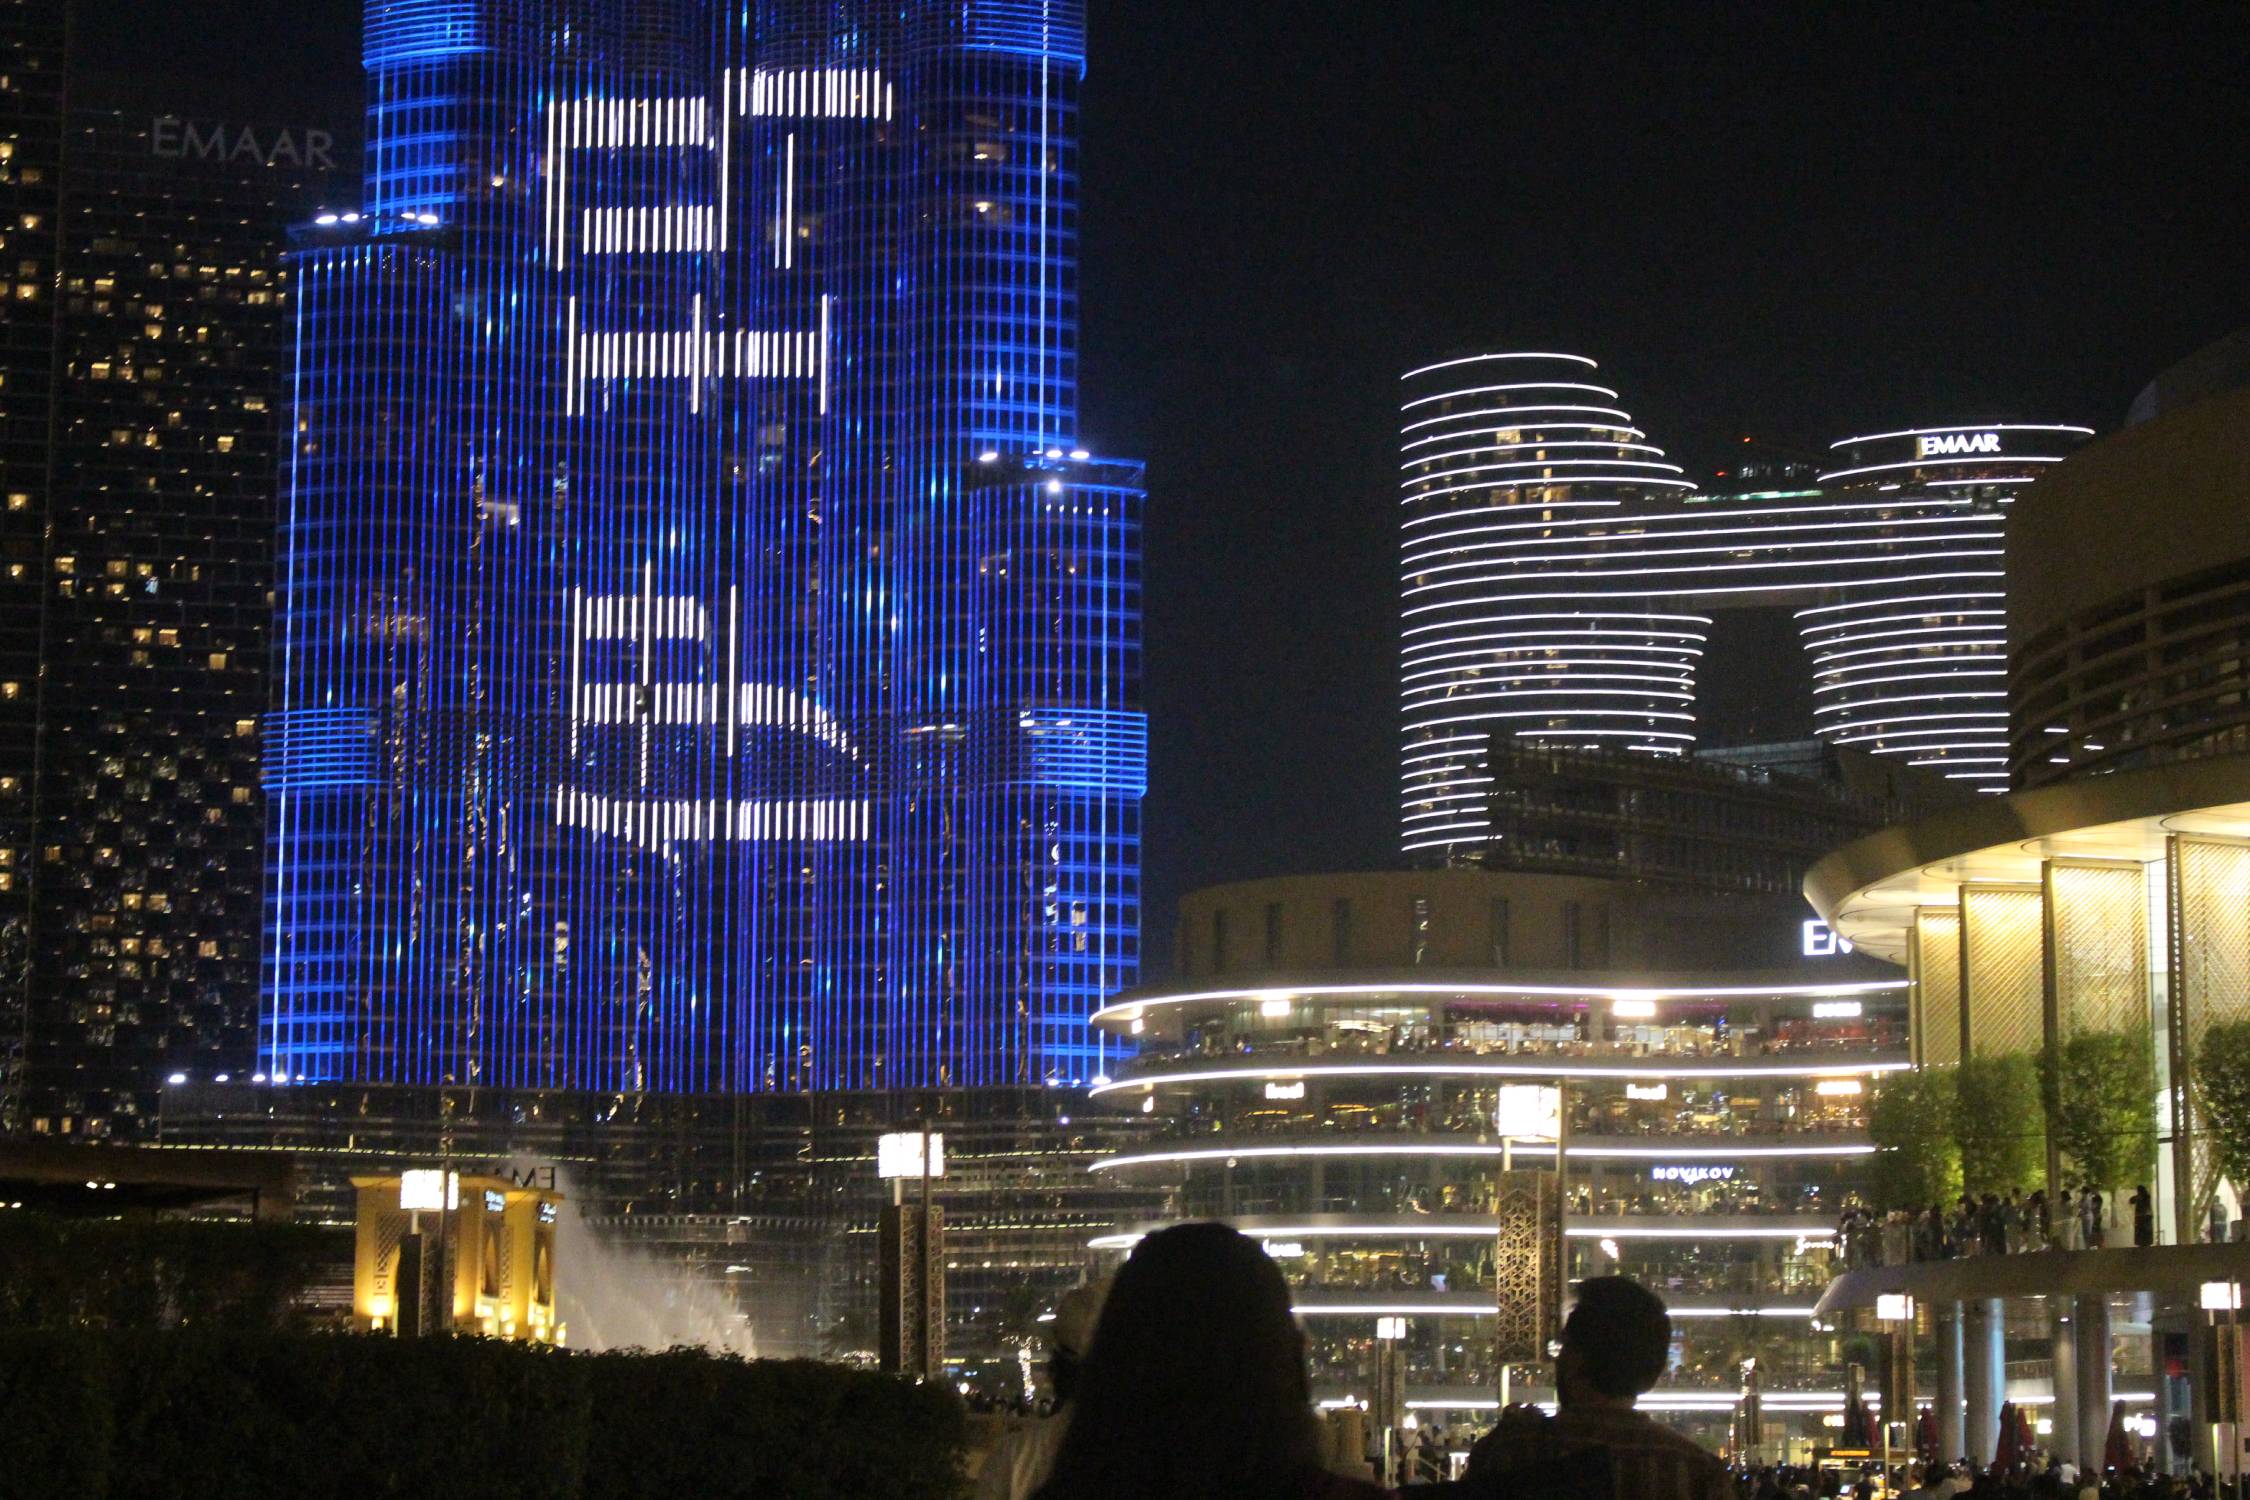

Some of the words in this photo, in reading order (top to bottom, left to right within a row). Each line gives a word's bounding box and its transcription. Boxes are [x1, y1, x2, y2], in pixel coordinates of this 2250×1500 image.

[151, 117, 336, 169] EMAAR
[1920, 433, 2002, 456] EMAAR
[1652, 1167, 1734, 1181] NOVIKOV
